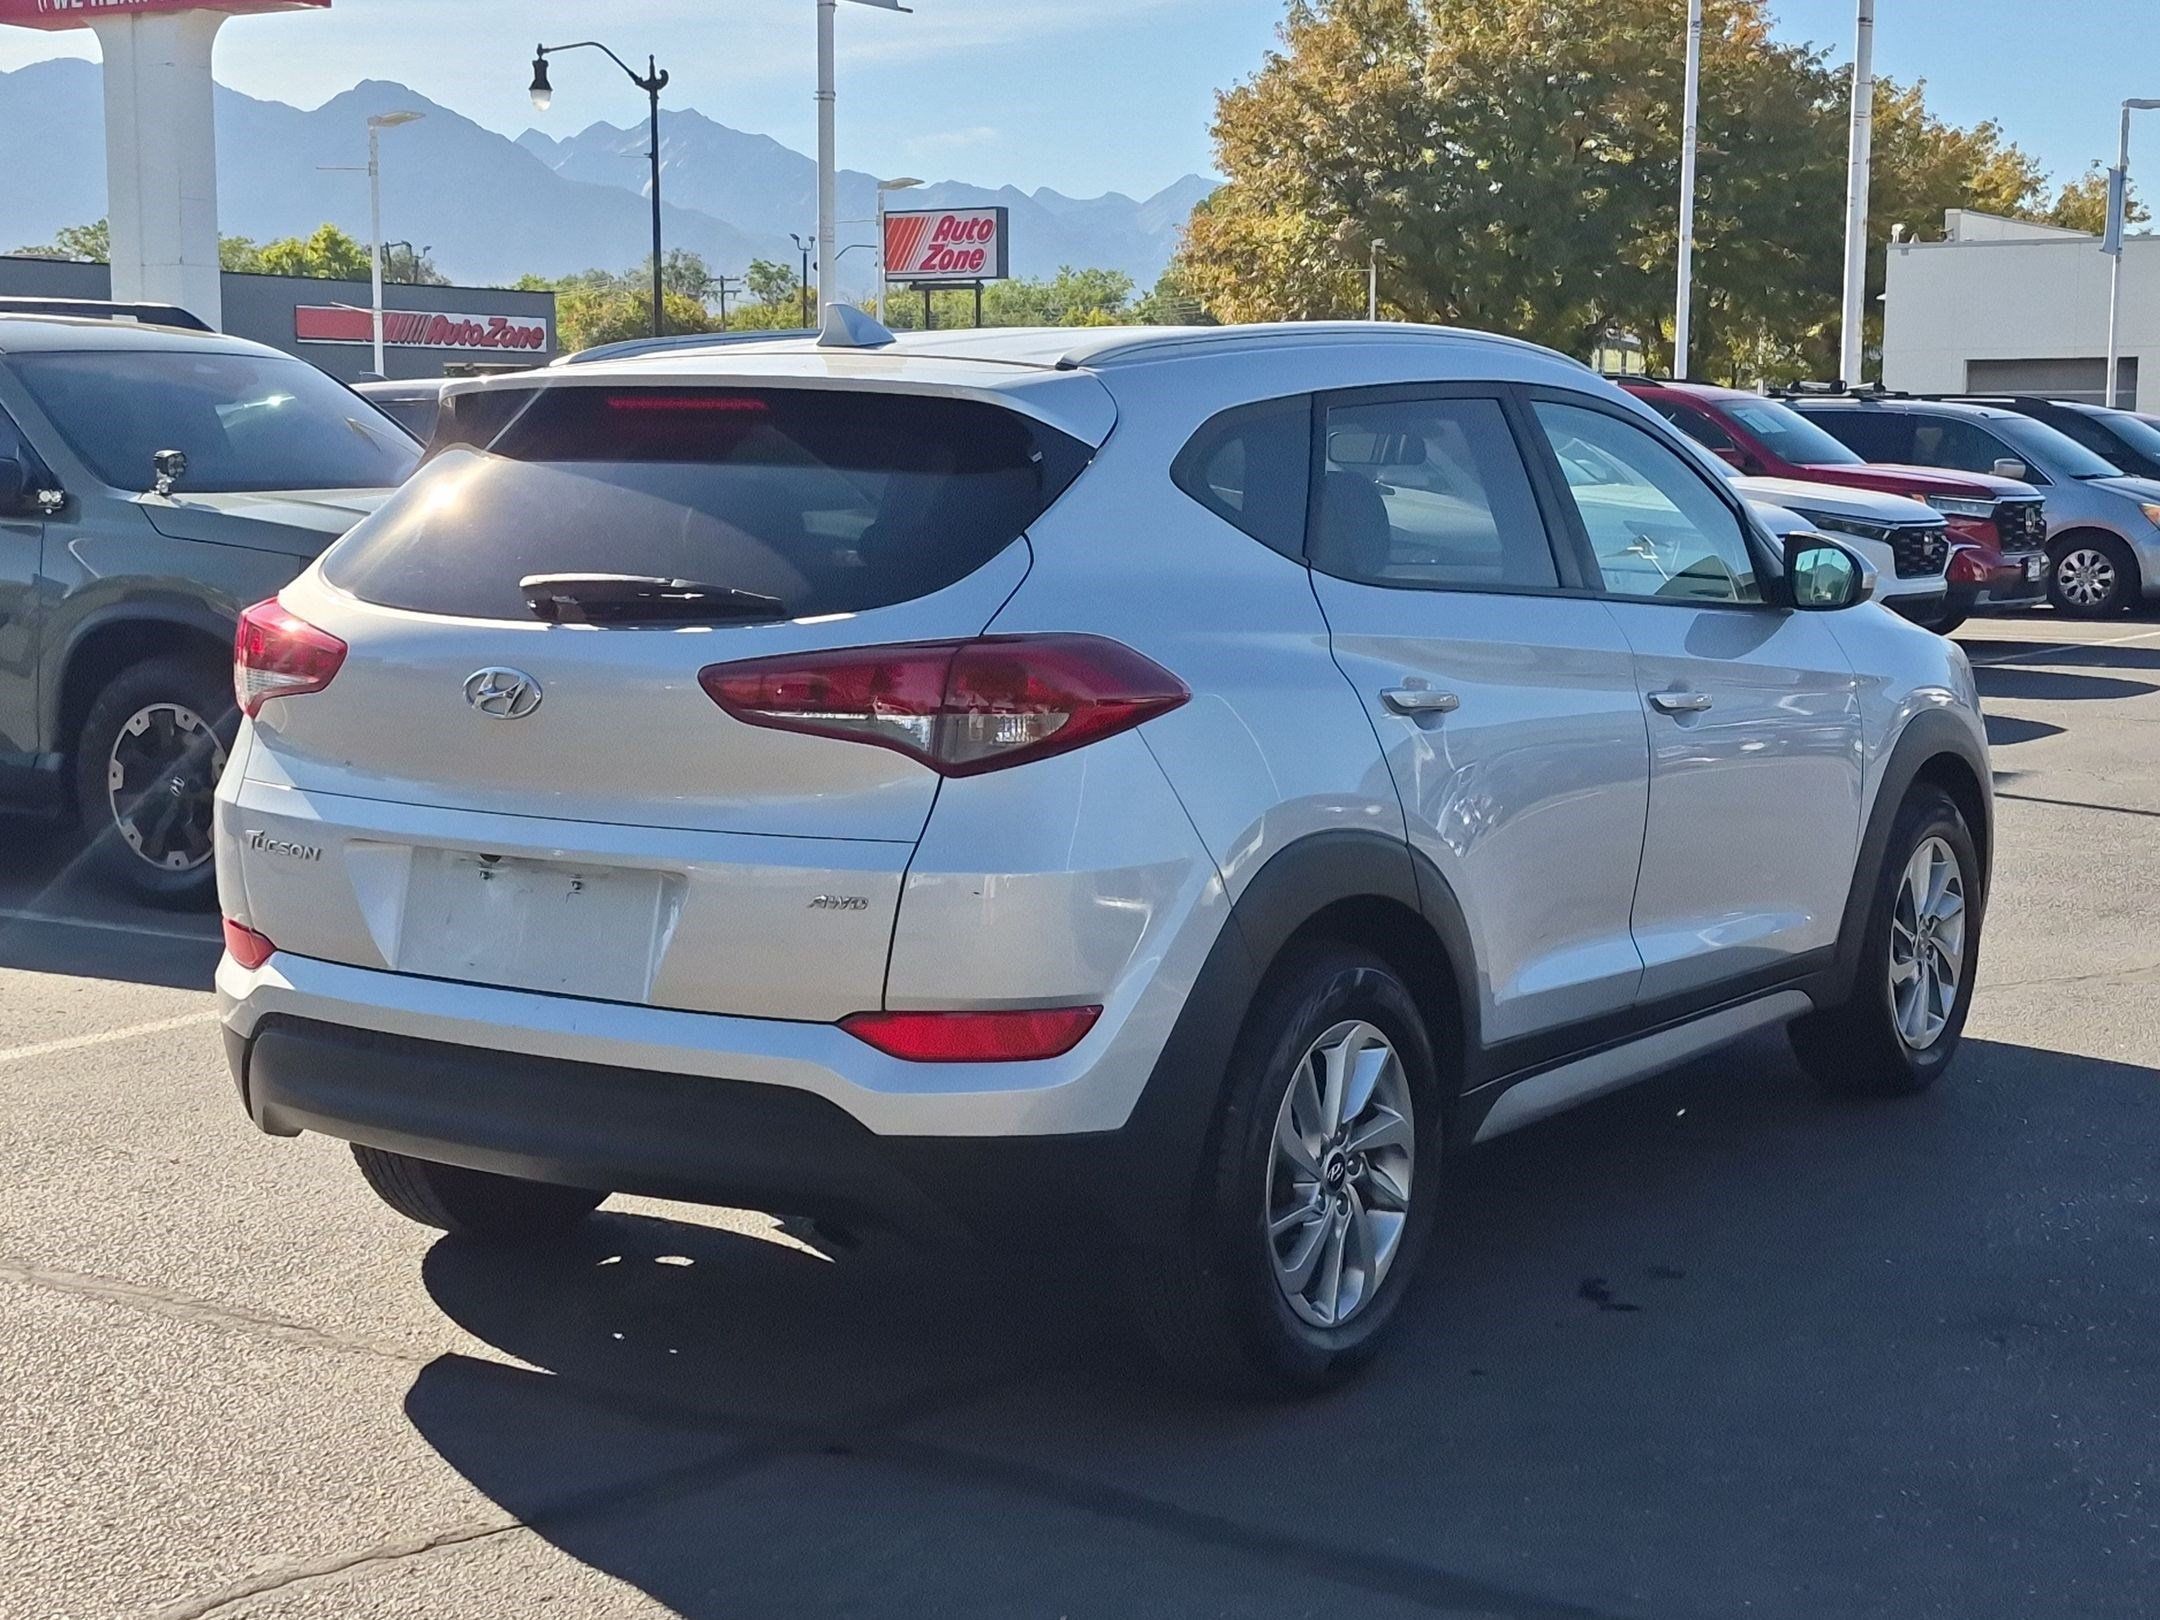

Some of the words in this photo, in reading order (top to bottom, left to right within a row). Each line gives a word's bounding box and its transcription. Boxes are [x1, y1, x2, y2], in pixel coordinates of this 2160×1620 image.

[932, 215, 994, 242] Auto
[919, 244, 985, 271] Zone
[245, 829, 321, 861] TUCSON
[808, 894, 869, 911] AWD
